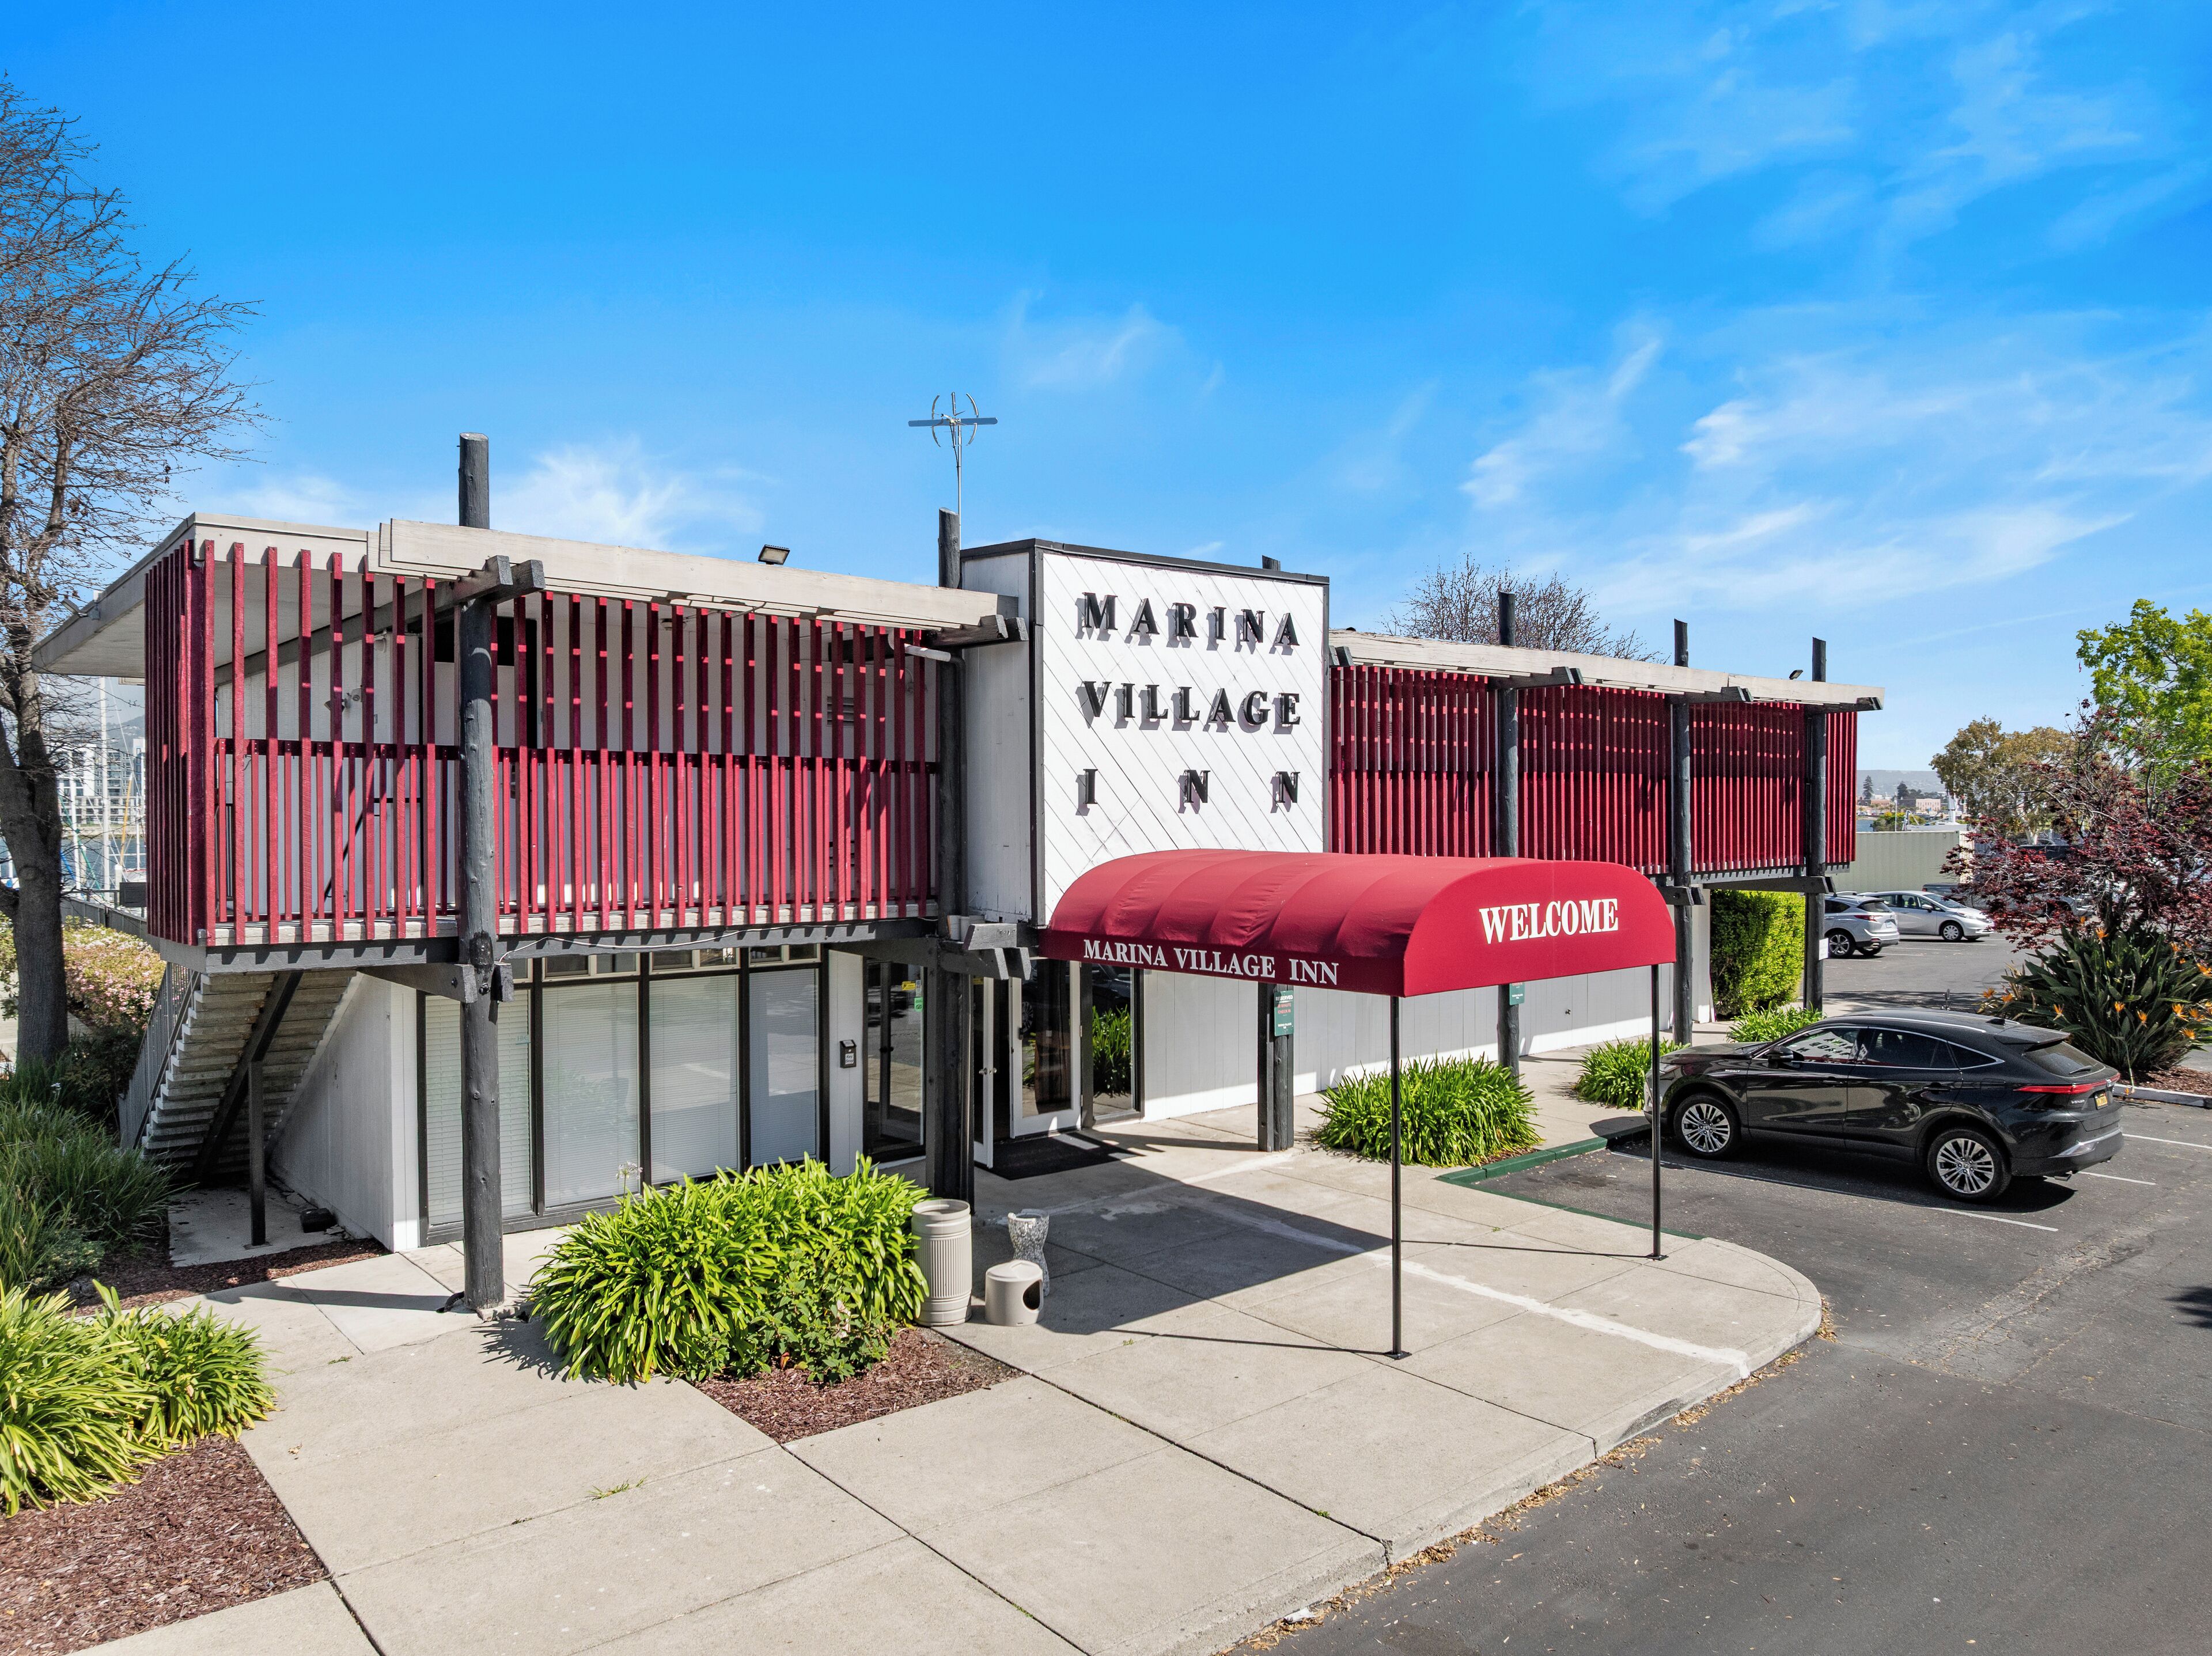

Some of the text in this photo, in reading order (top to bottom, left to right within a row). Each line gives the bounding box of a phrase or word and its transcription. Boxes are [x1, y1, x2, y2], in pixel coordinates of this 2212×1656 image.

[1081, 591, 1300, 646] MARINA
[1082, 680, 1301, 725] VILLAGE
[1083, 768, 1301, 805] INN
[1478, 897, 1619, 945] WELCOME
[1083, 939, 1339, 986] MARINA VILLAGE INN
